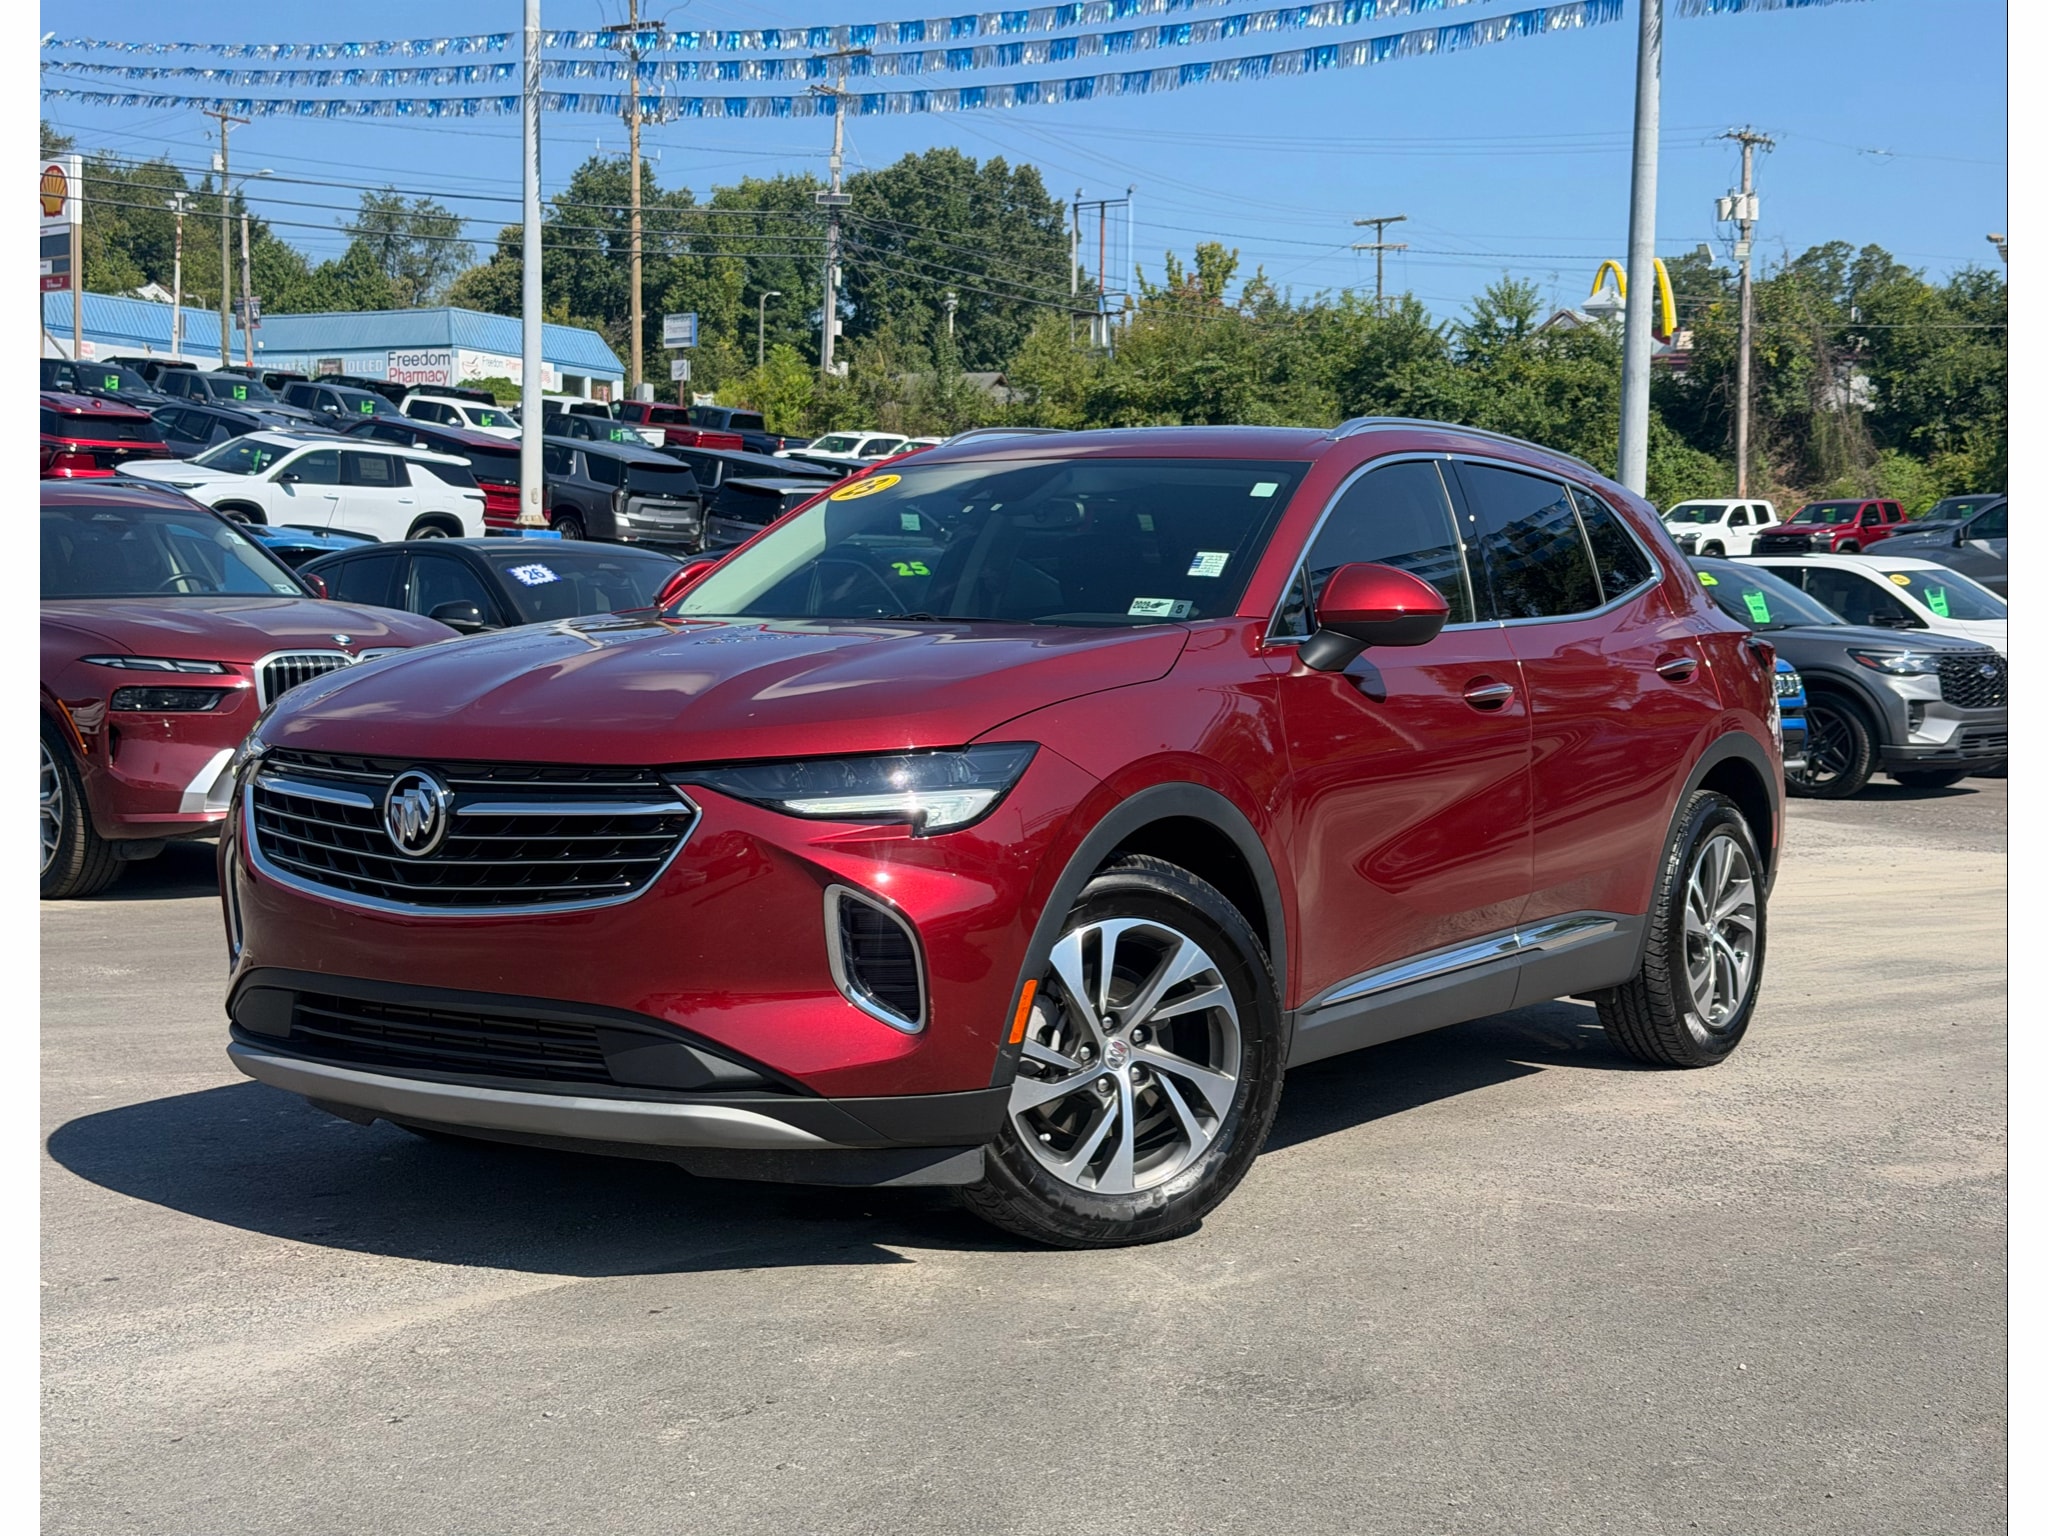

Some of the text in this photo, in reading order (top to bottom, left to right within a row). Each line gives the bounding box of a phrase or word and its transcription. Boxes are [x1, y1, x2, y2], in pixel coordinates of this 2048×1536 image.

[388, 350, 450, 367] Freedom
[389, 367, 449, 386] Pharmacy
[522, 568, 546, 580] 26
[891, 561, 931, 576] 25
[1175, 604, 1185, 614] 8
